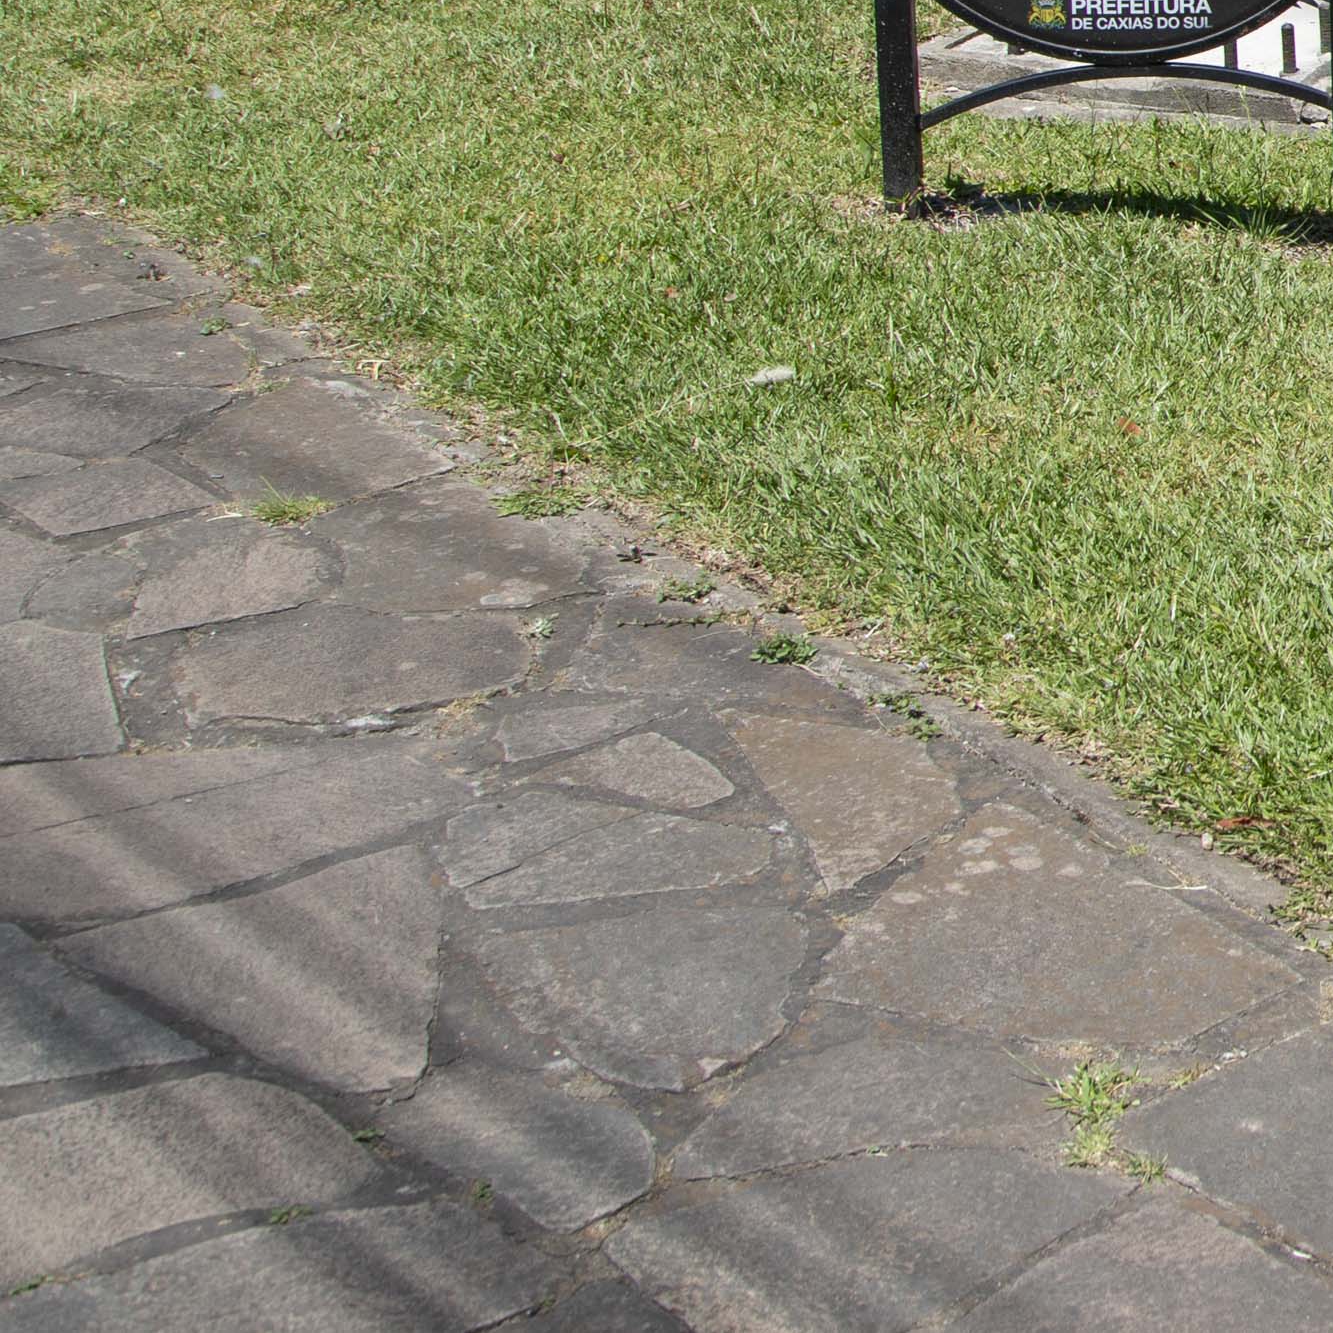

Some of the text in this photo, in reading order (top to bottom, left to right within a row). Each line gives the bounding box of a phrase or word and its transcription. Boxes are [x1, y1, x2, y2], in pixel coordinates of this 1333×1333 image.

[1072, 15, 1212, 30] DE CAXIAS DO SUL
